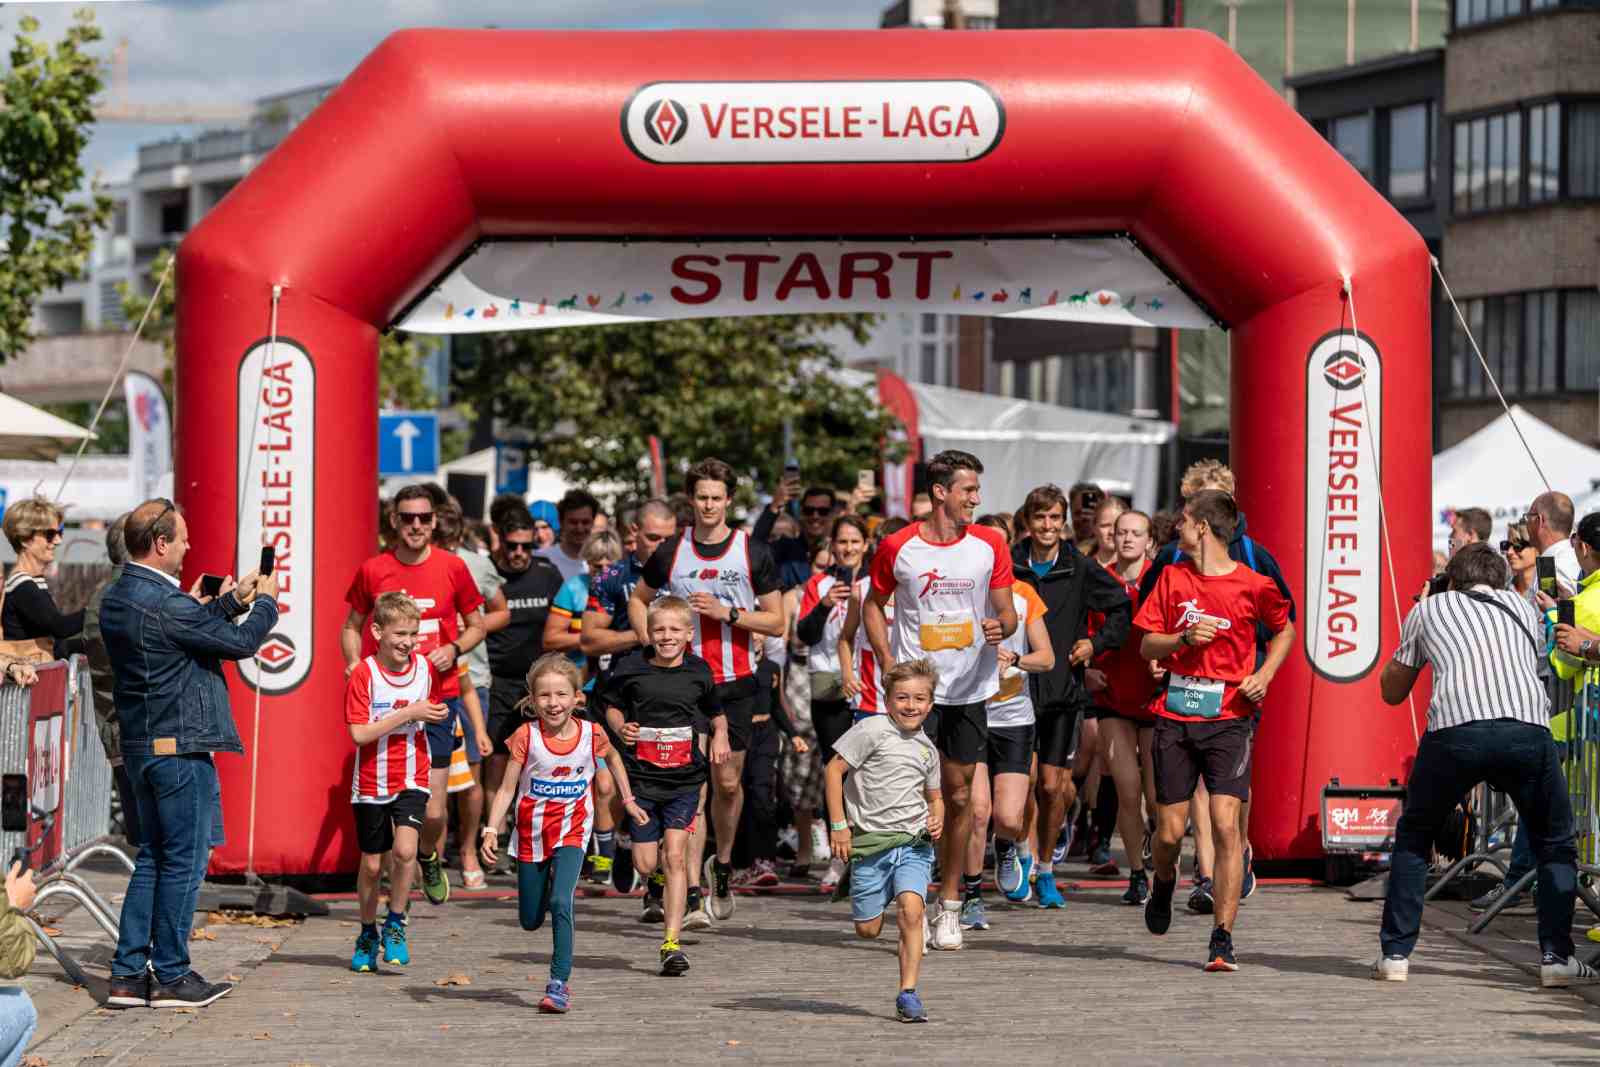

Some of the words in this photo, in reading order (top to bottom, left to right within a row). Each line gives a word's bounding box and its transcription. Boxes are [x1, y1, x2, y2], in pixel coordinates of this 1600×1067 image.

[700, 102, 980, 139] VERSELE-LAGA
[670, 251, 953, 305] START
[1327, 402, 1363, 659] VERSELE-LAGA
[533, 782, 585, 796] DECATHLON
